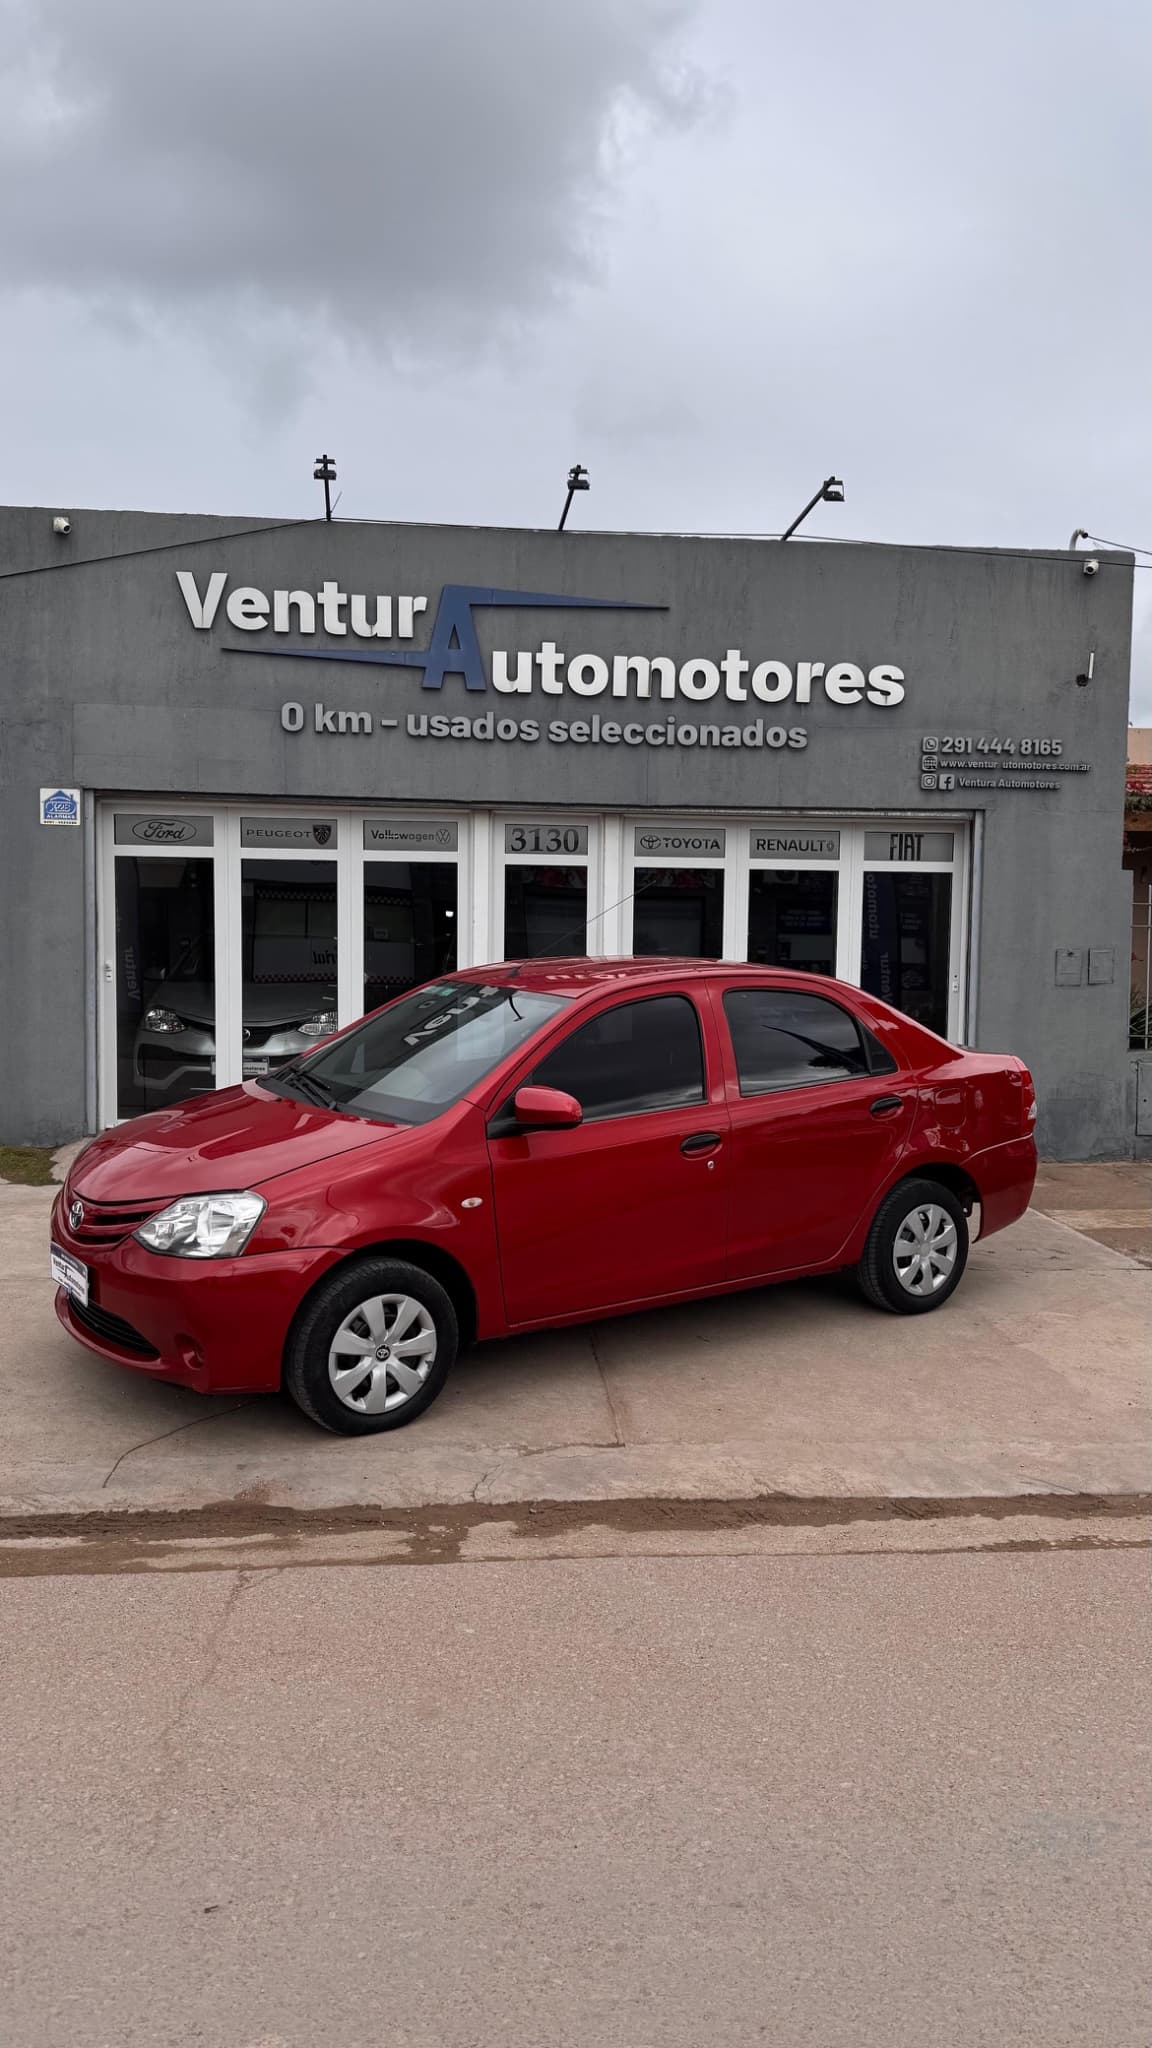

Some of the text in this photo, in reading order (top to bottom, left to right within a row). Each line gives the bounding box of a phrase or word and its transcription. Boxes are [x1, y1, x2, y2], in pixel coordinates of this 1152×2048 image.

[281, 702, 304, 732] 0
[314, 704, 372, 733] km
[406, 711, 540, 742] usados
[548, 715, 808, 748] seleccionados
[941, 736, 1063, 755] 291 444 8165
[958, 777, 1060, 790] Ventura Automotores
[144, 821, 185, 839] Ford
[246, 829, 313, 838] PEUGEOT
[371, 829, 435, 842] Volkswagen
[510, 827, 579, 853] 3130
[663, 837, 720, 849] TOYOTA
[756, 838, 826, 852] RENAULT
[890, 833, 924, 861] FIAT
